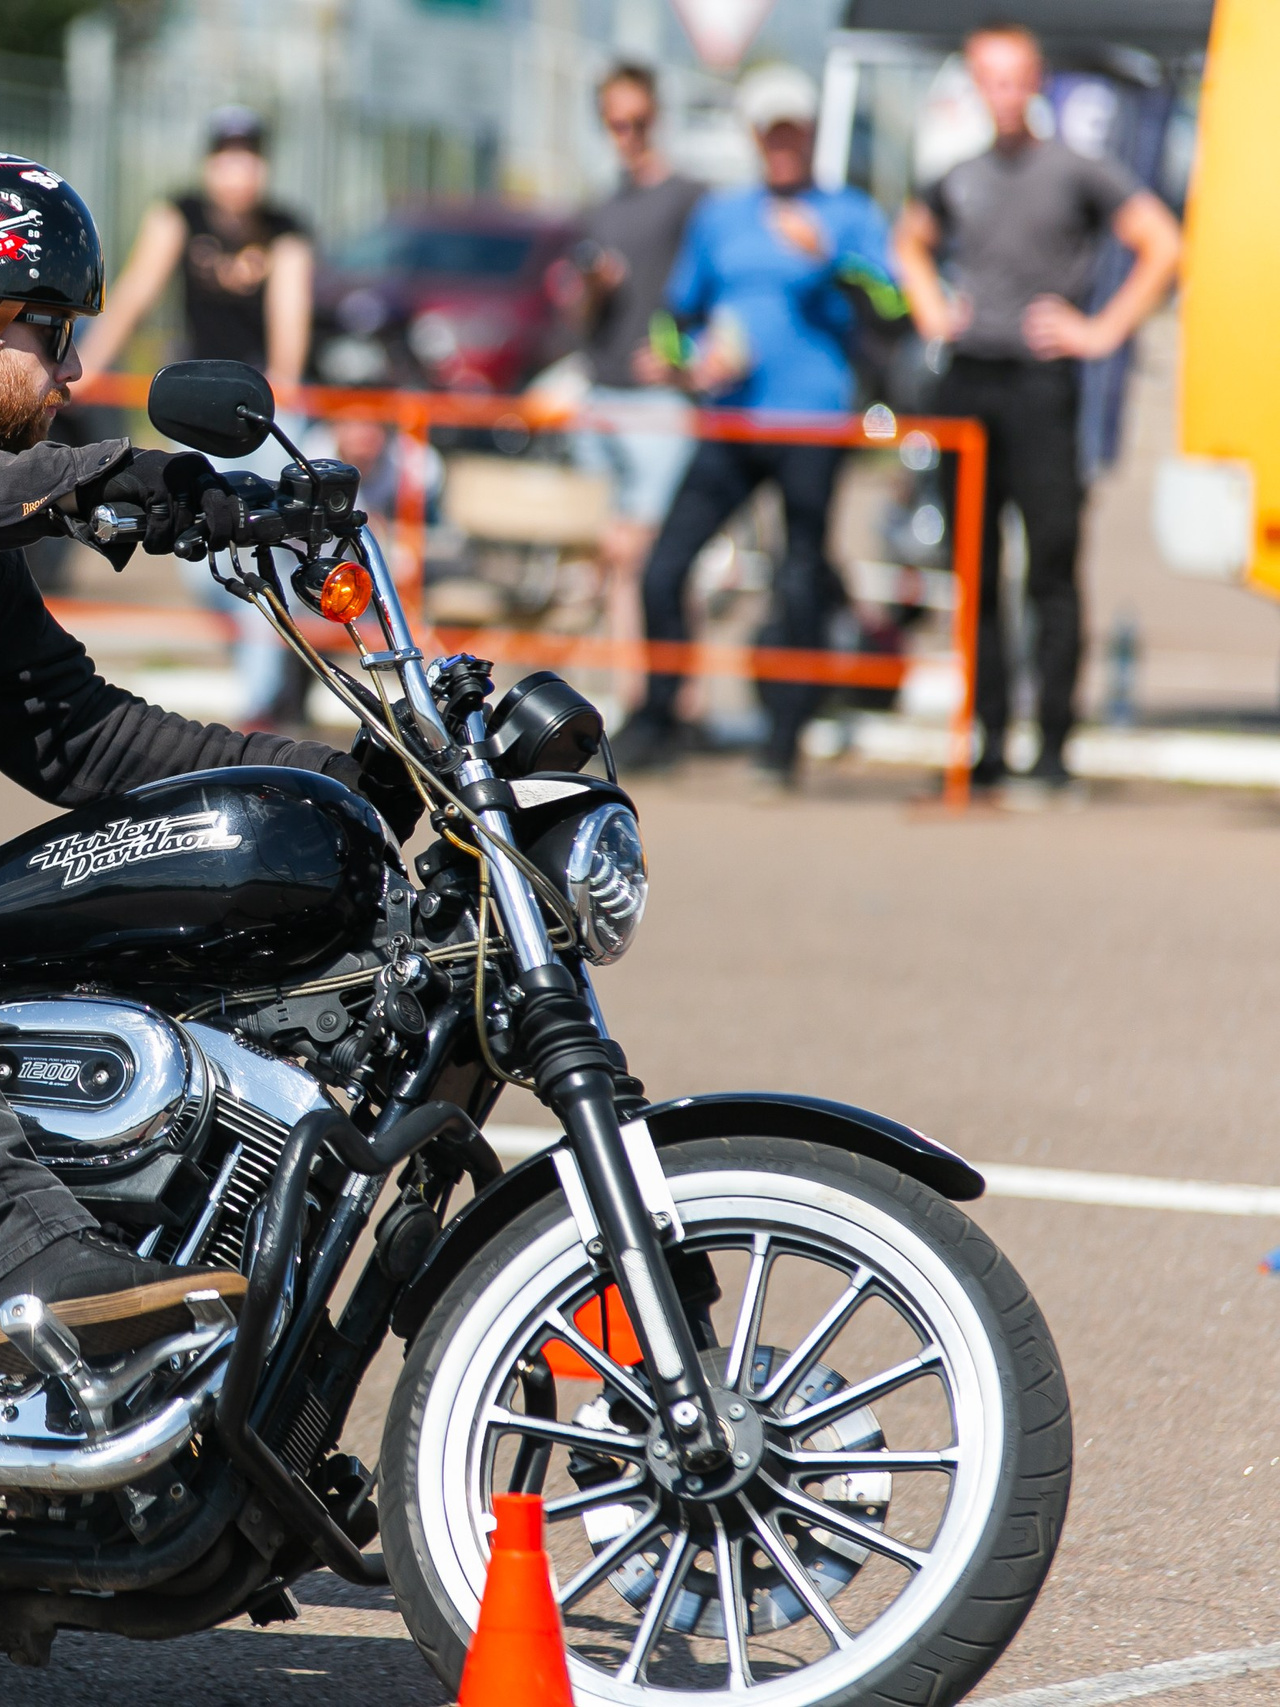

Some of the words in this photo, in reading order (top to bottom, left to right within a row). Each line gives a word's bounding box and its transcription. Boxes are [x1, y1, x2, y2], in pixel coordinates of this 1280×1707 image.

[28, 811, 219, 870] Harley
[62, 828, 242, 887] Davidson
[17, 1061, 81, 1082] 1200
